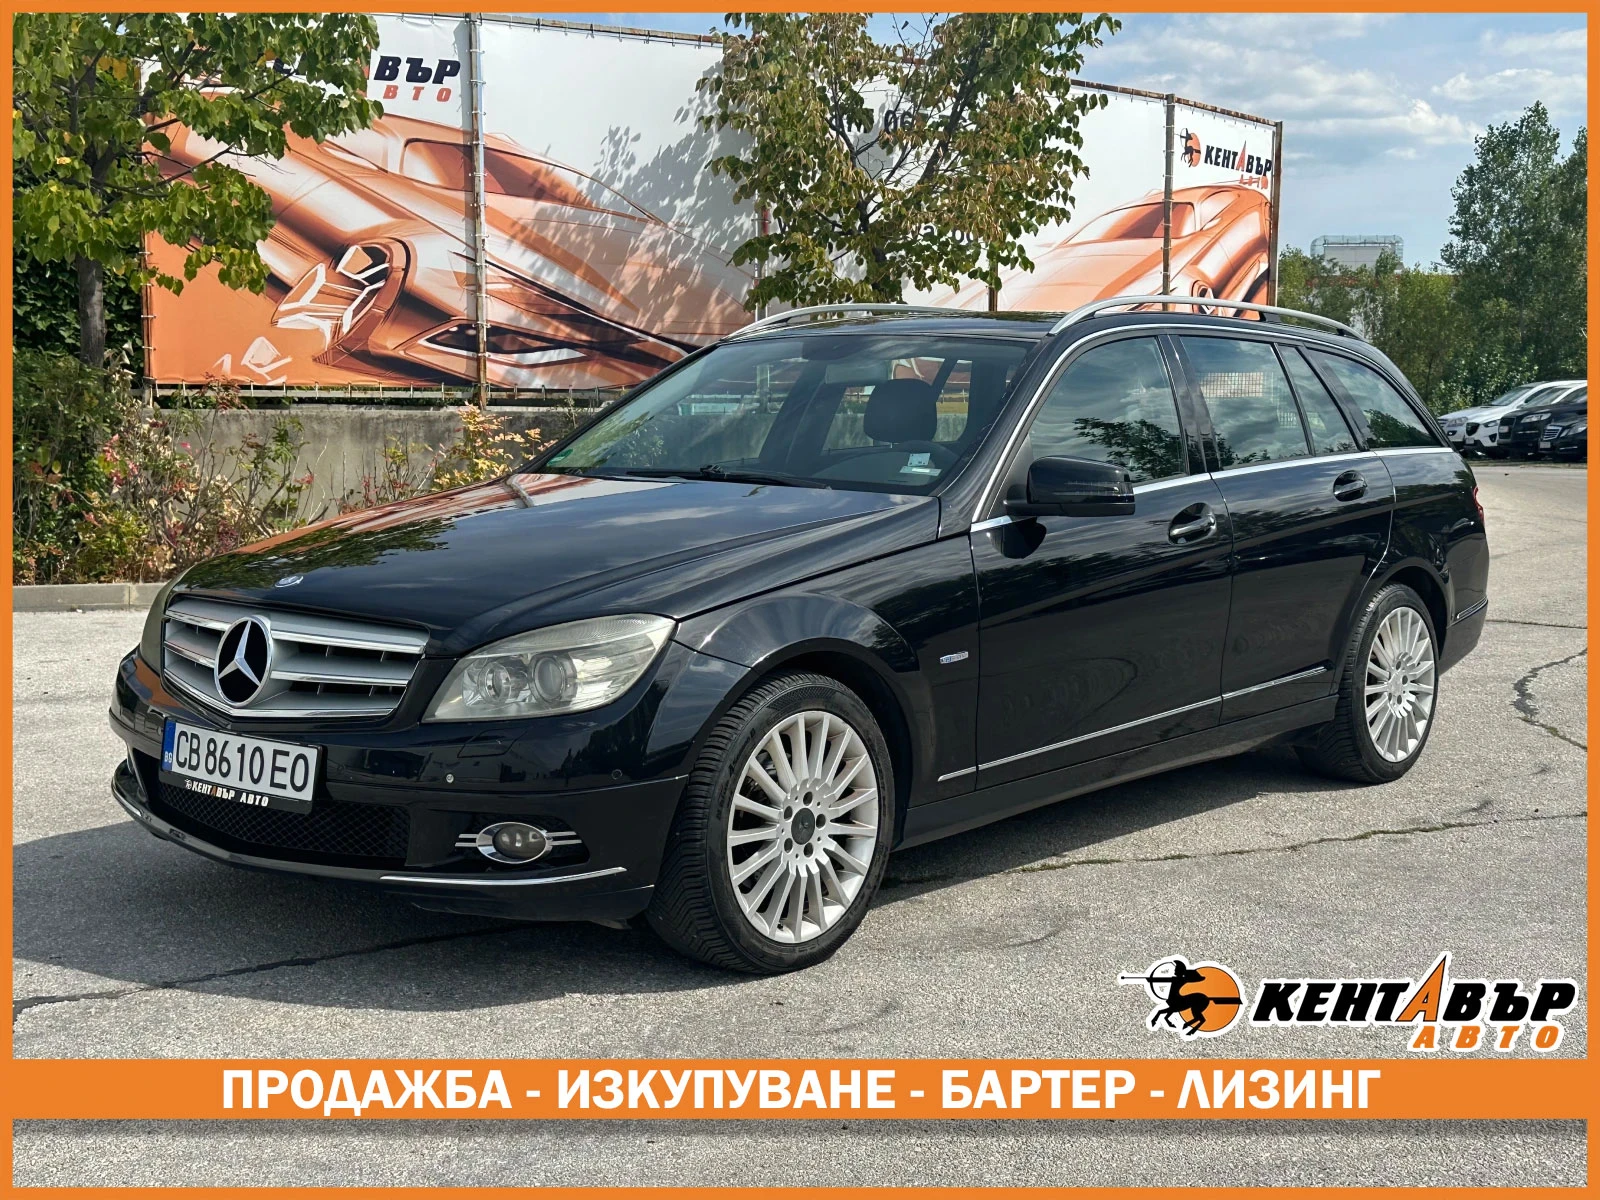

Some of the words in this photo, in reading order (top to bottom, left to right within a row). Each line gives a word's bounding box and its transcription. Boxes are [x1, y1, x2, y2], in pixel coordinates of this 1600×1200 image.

[1204, 140, 1273, 176] КЕНТАВЪР
[192, 780, 235, 800] КЕНТАВЪР
[240, 792, 269, 807] АВТО
